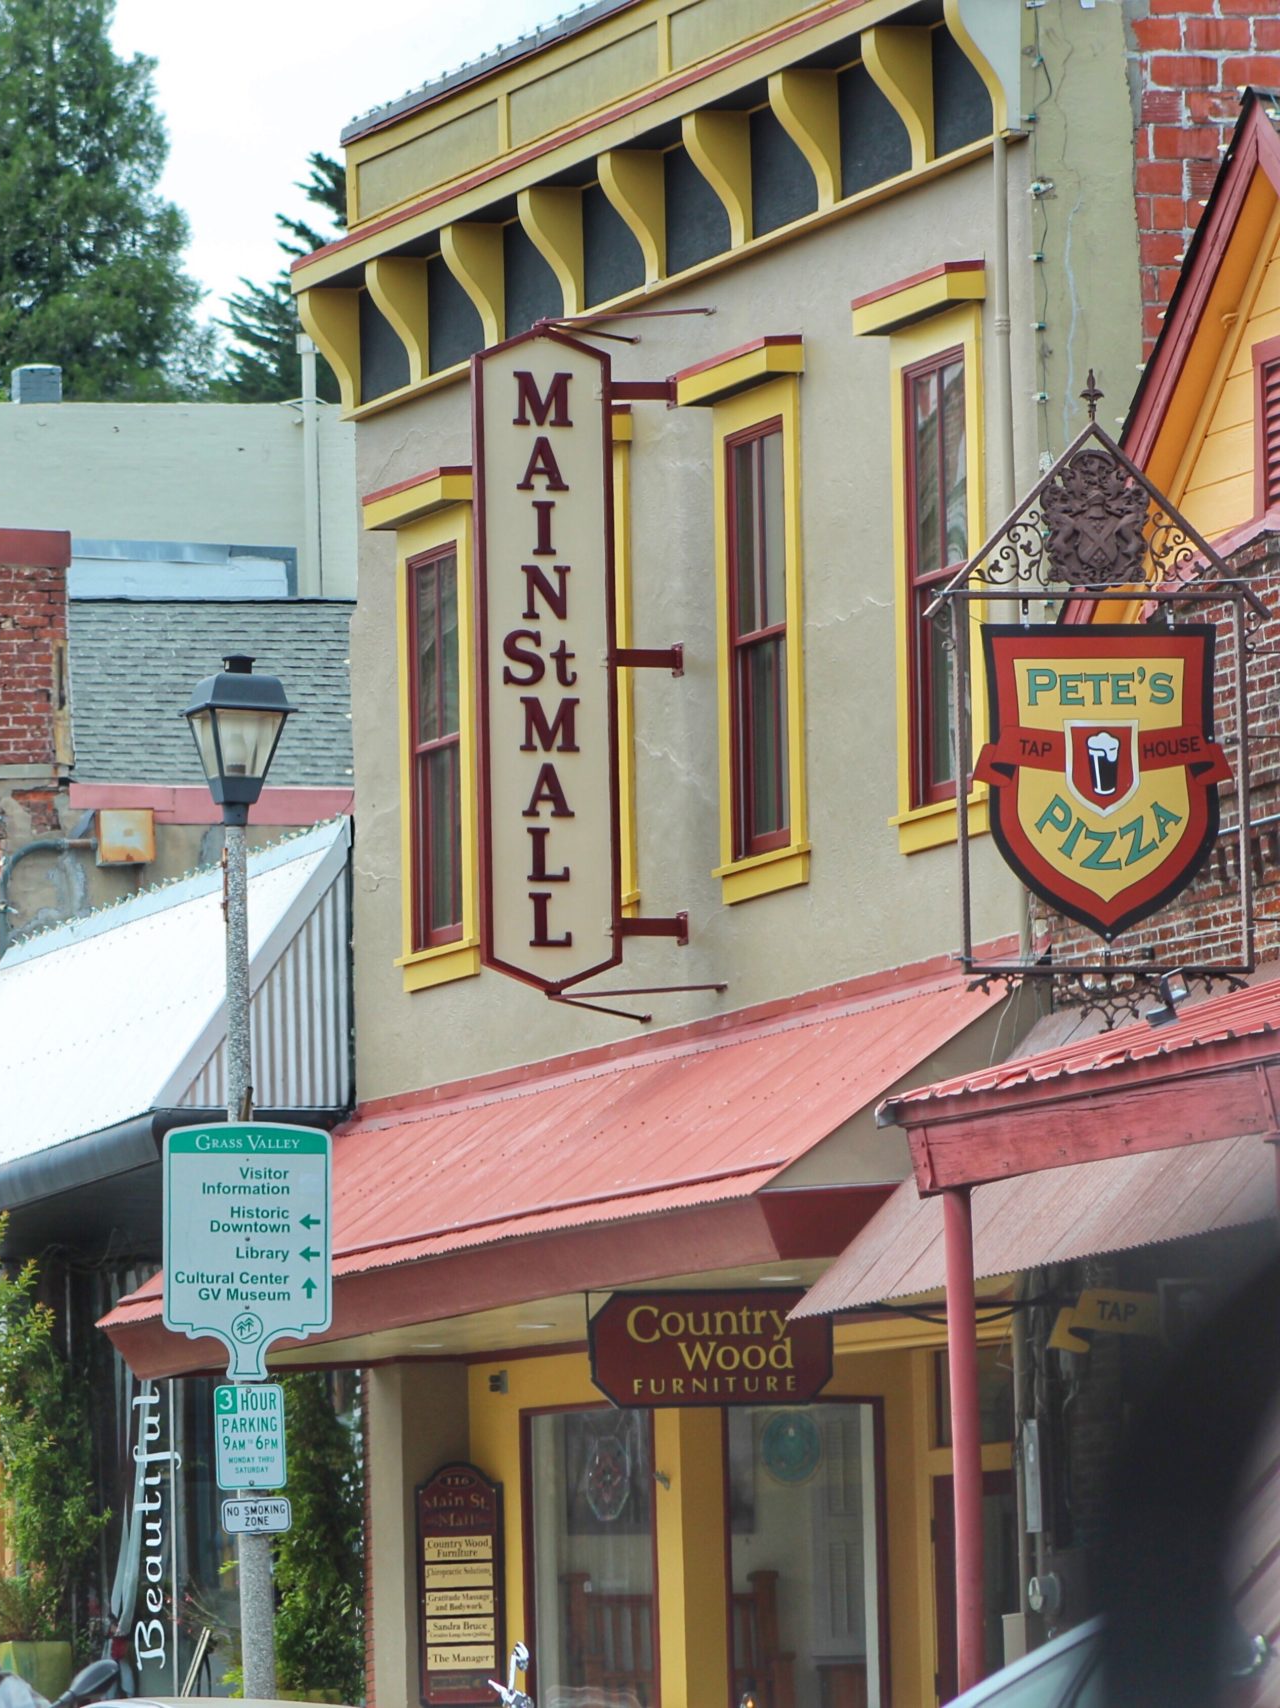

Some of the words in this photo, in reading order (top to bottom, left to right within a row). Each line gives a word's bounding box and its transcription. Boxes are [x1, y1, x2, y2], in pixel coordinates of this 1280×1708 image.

[512, 370, 573, 621] MAIN
[503, 629, 577, 687] St
[1026, 666, 1175, 706] PETE'S
[1019, 738, 1053, 757] TAP
[1143, 735, 1201, 759] HOUSE
[519, 696, 580, 948] MALL
[1034, 793, 1183, 871] PIZZA
[195, 1134, 243, 1150] GRASS
[246, 1134, 301, 1150] VALLEY
[239, 1166, 290, 1180] Visitor
[201, 1182, 291, 1195] Information
[230, 1206, 290, 1219] Historic
[210, 1220, 291, 1233] Downtown
[235, 1246, 290, 1263] Library
[174, 1271, 235, 1284] Cultural
[239, 1272, 290, 1285] Center
[198, 1288, 222, 1301] GV
[226, 1288, 291, 1301] Museum
[1096, 1300, 1138, 1322] TAP
[626, 1304, 790, 1344] Country
[677, 1337, 795, 1372] Wood
[633, 1375, 797, 1395] FURNITURE
[219, 1389, 233, 1410] 3
[241, 1392, 277, 1412] HOUR
[222, 1416, 278, 1434] PARKING
[223, 1435, 246, 1450] 9AM
[255, 1434, 278, 1450] 6PM
[228, 1456, 256, 1465] MONDAY
[258, 1456, 276, 1464] THRU
[235, 1466, 270, 1474] SATURDAY
[424, 1492, 465, 1509] Main
[226, 1506, 240, 1517] NO
[244, 1503, 286, 1516] SMOKING
[244, 1515, 270, 1527] ZONE
[438, 1512, 475, 1527] Mall
[132, 1386, 182, 1671] Beautiful
[427, 1540, 463, 1552] Country
[464, 1538, 489, 1548] Wood
[436, 1549, 478, 1558] Furniture
[435, 1603, 448, 1611] and
[432, 1621, 462, 1631] Sandra
[463, 1621, 488, 1630] Bruce
[432, 1653, 450, 1664] The
[452, 1652, 490, 1664] Manager
